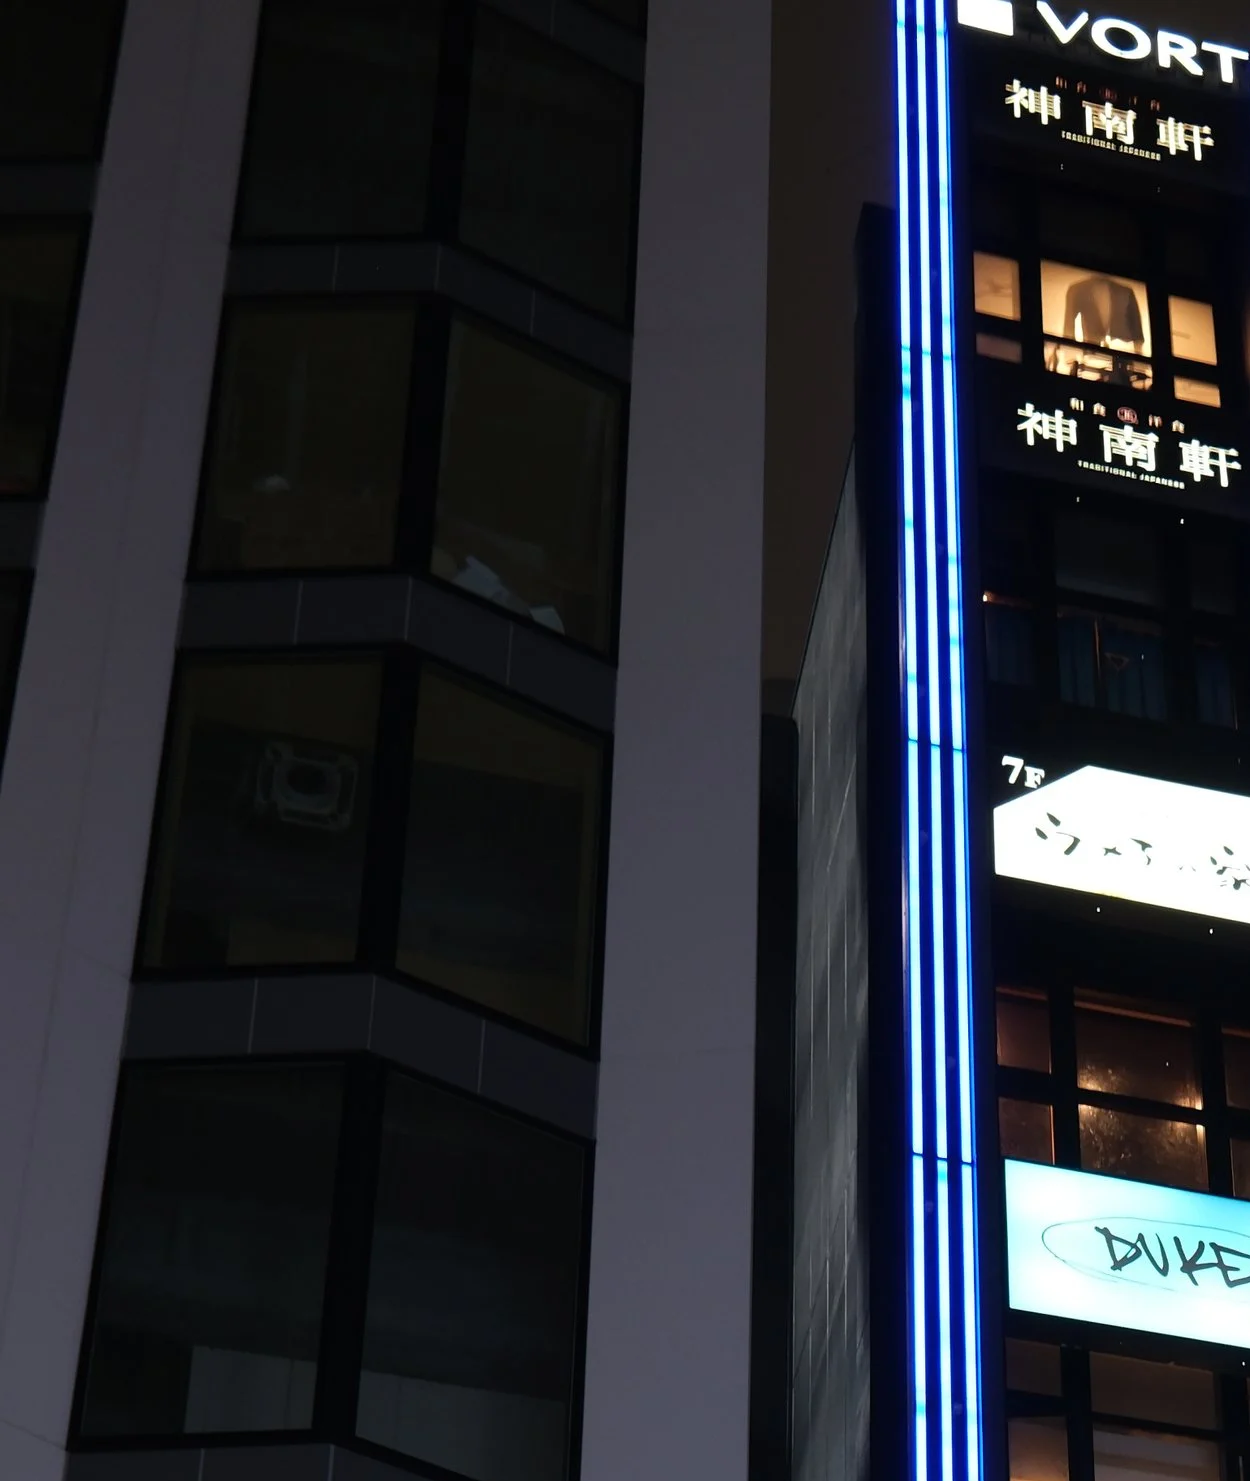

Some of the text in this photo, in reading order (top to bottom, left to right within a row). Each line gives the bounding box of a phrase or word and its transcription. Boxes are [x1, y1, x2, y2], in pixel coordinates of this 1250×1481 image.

[1035, 0, 1250, 84] VORT
[1005, 78, 1215, 162] 神南軒
[1016, 402, 1242, 488] 神南軒
[1001, 755, 1046, 789] 7F
